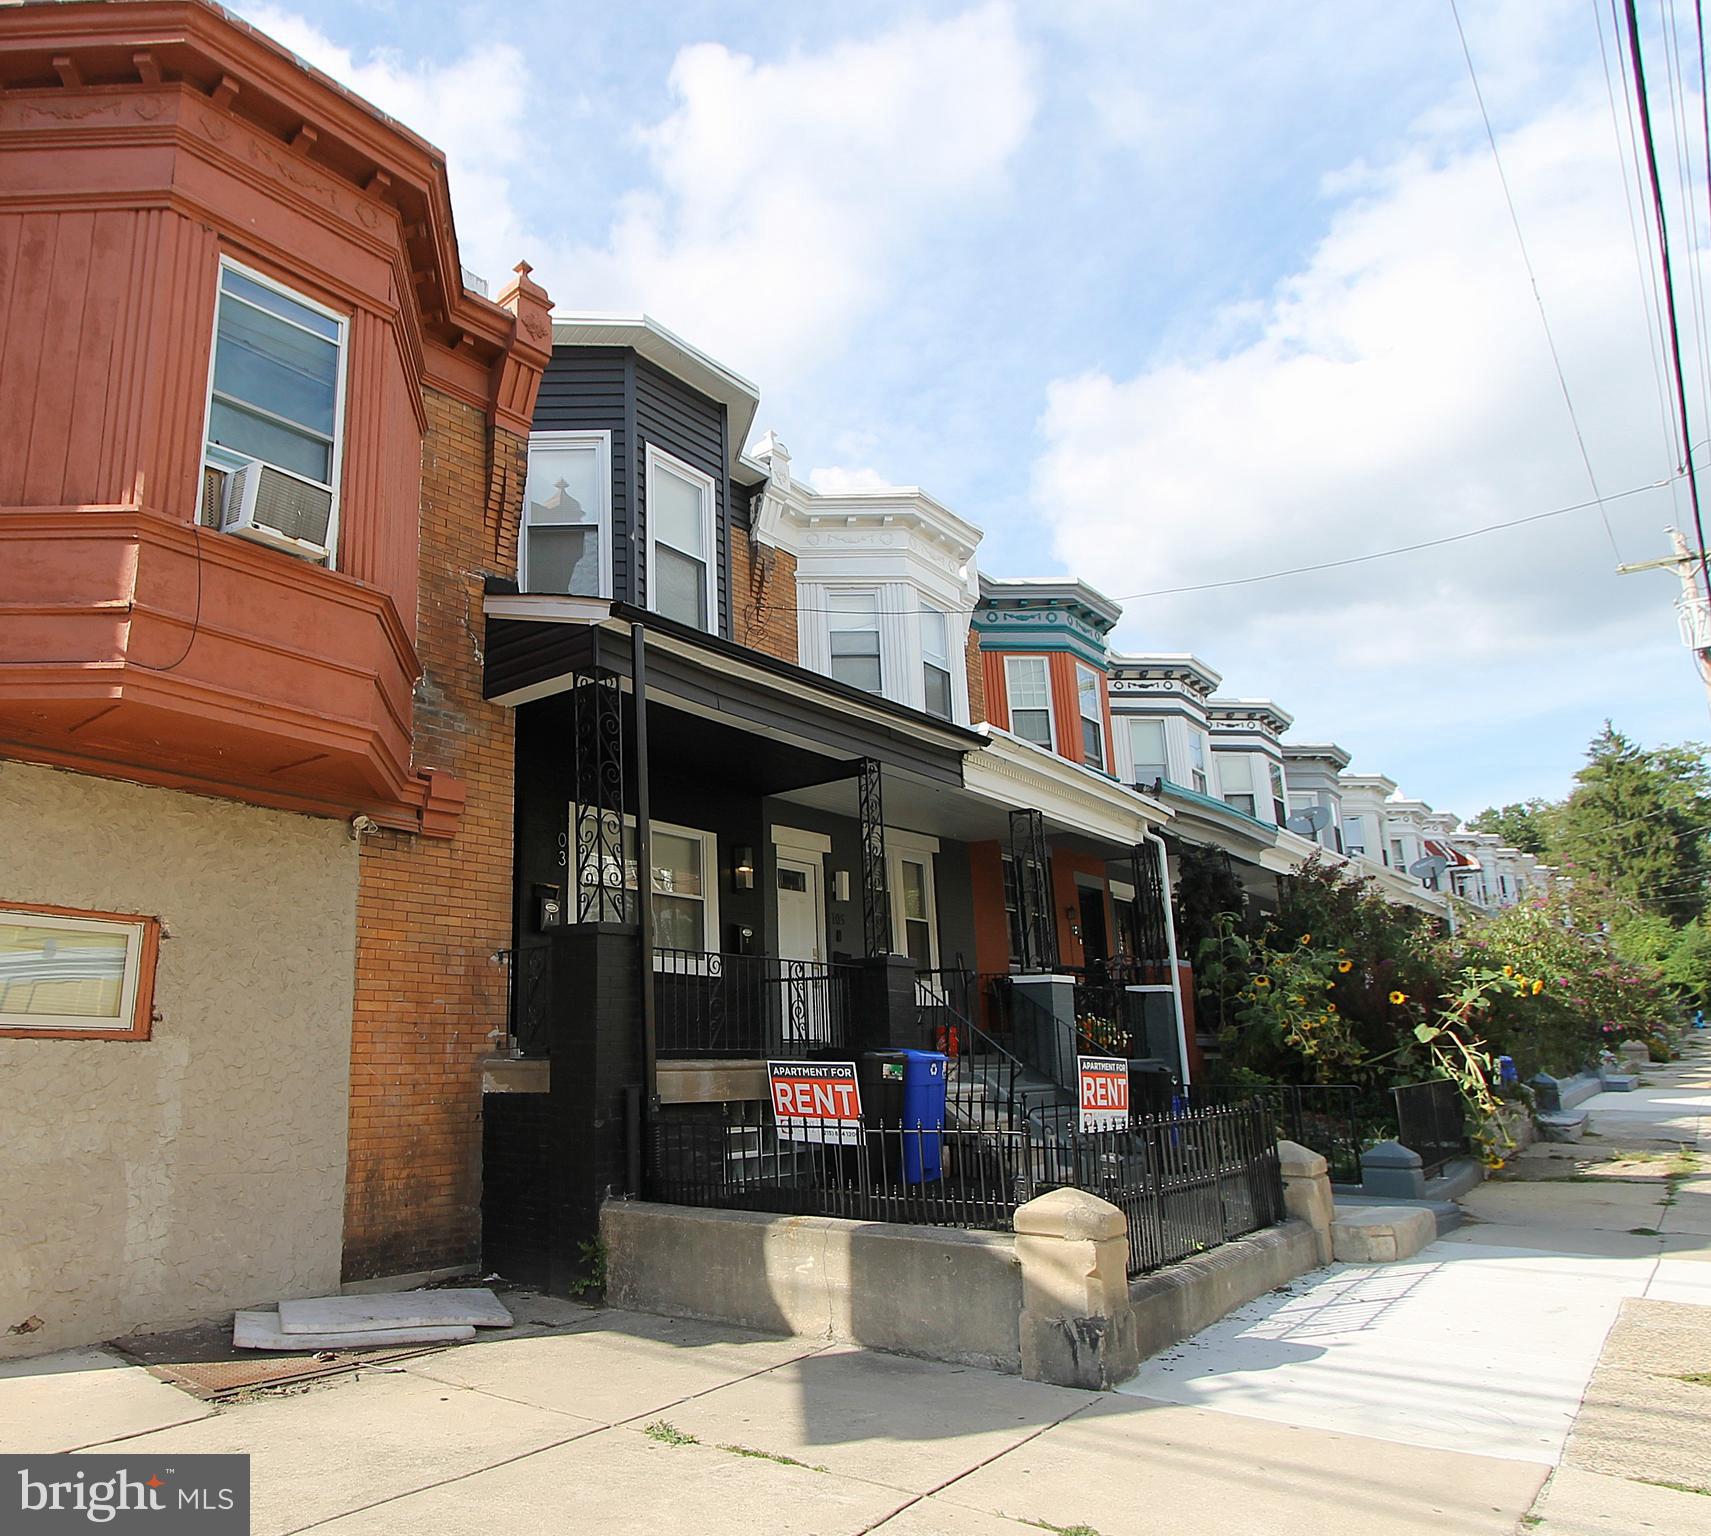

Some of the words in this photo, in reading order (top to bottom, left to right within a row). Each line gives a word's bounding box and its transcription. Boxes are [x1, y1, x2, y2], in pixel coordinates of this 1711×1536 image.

[773, 1066, 828, 1077] APARTMENT
[831, 1068, 852, 1077] FOR
[1082, 1061, 1116, 1071] APARTMENT
[1116, 1064, 1126, 1072] FOR
[774, 1082, 854, 1116] RENT
[1083, 1076, 1127, 1107] RENT
